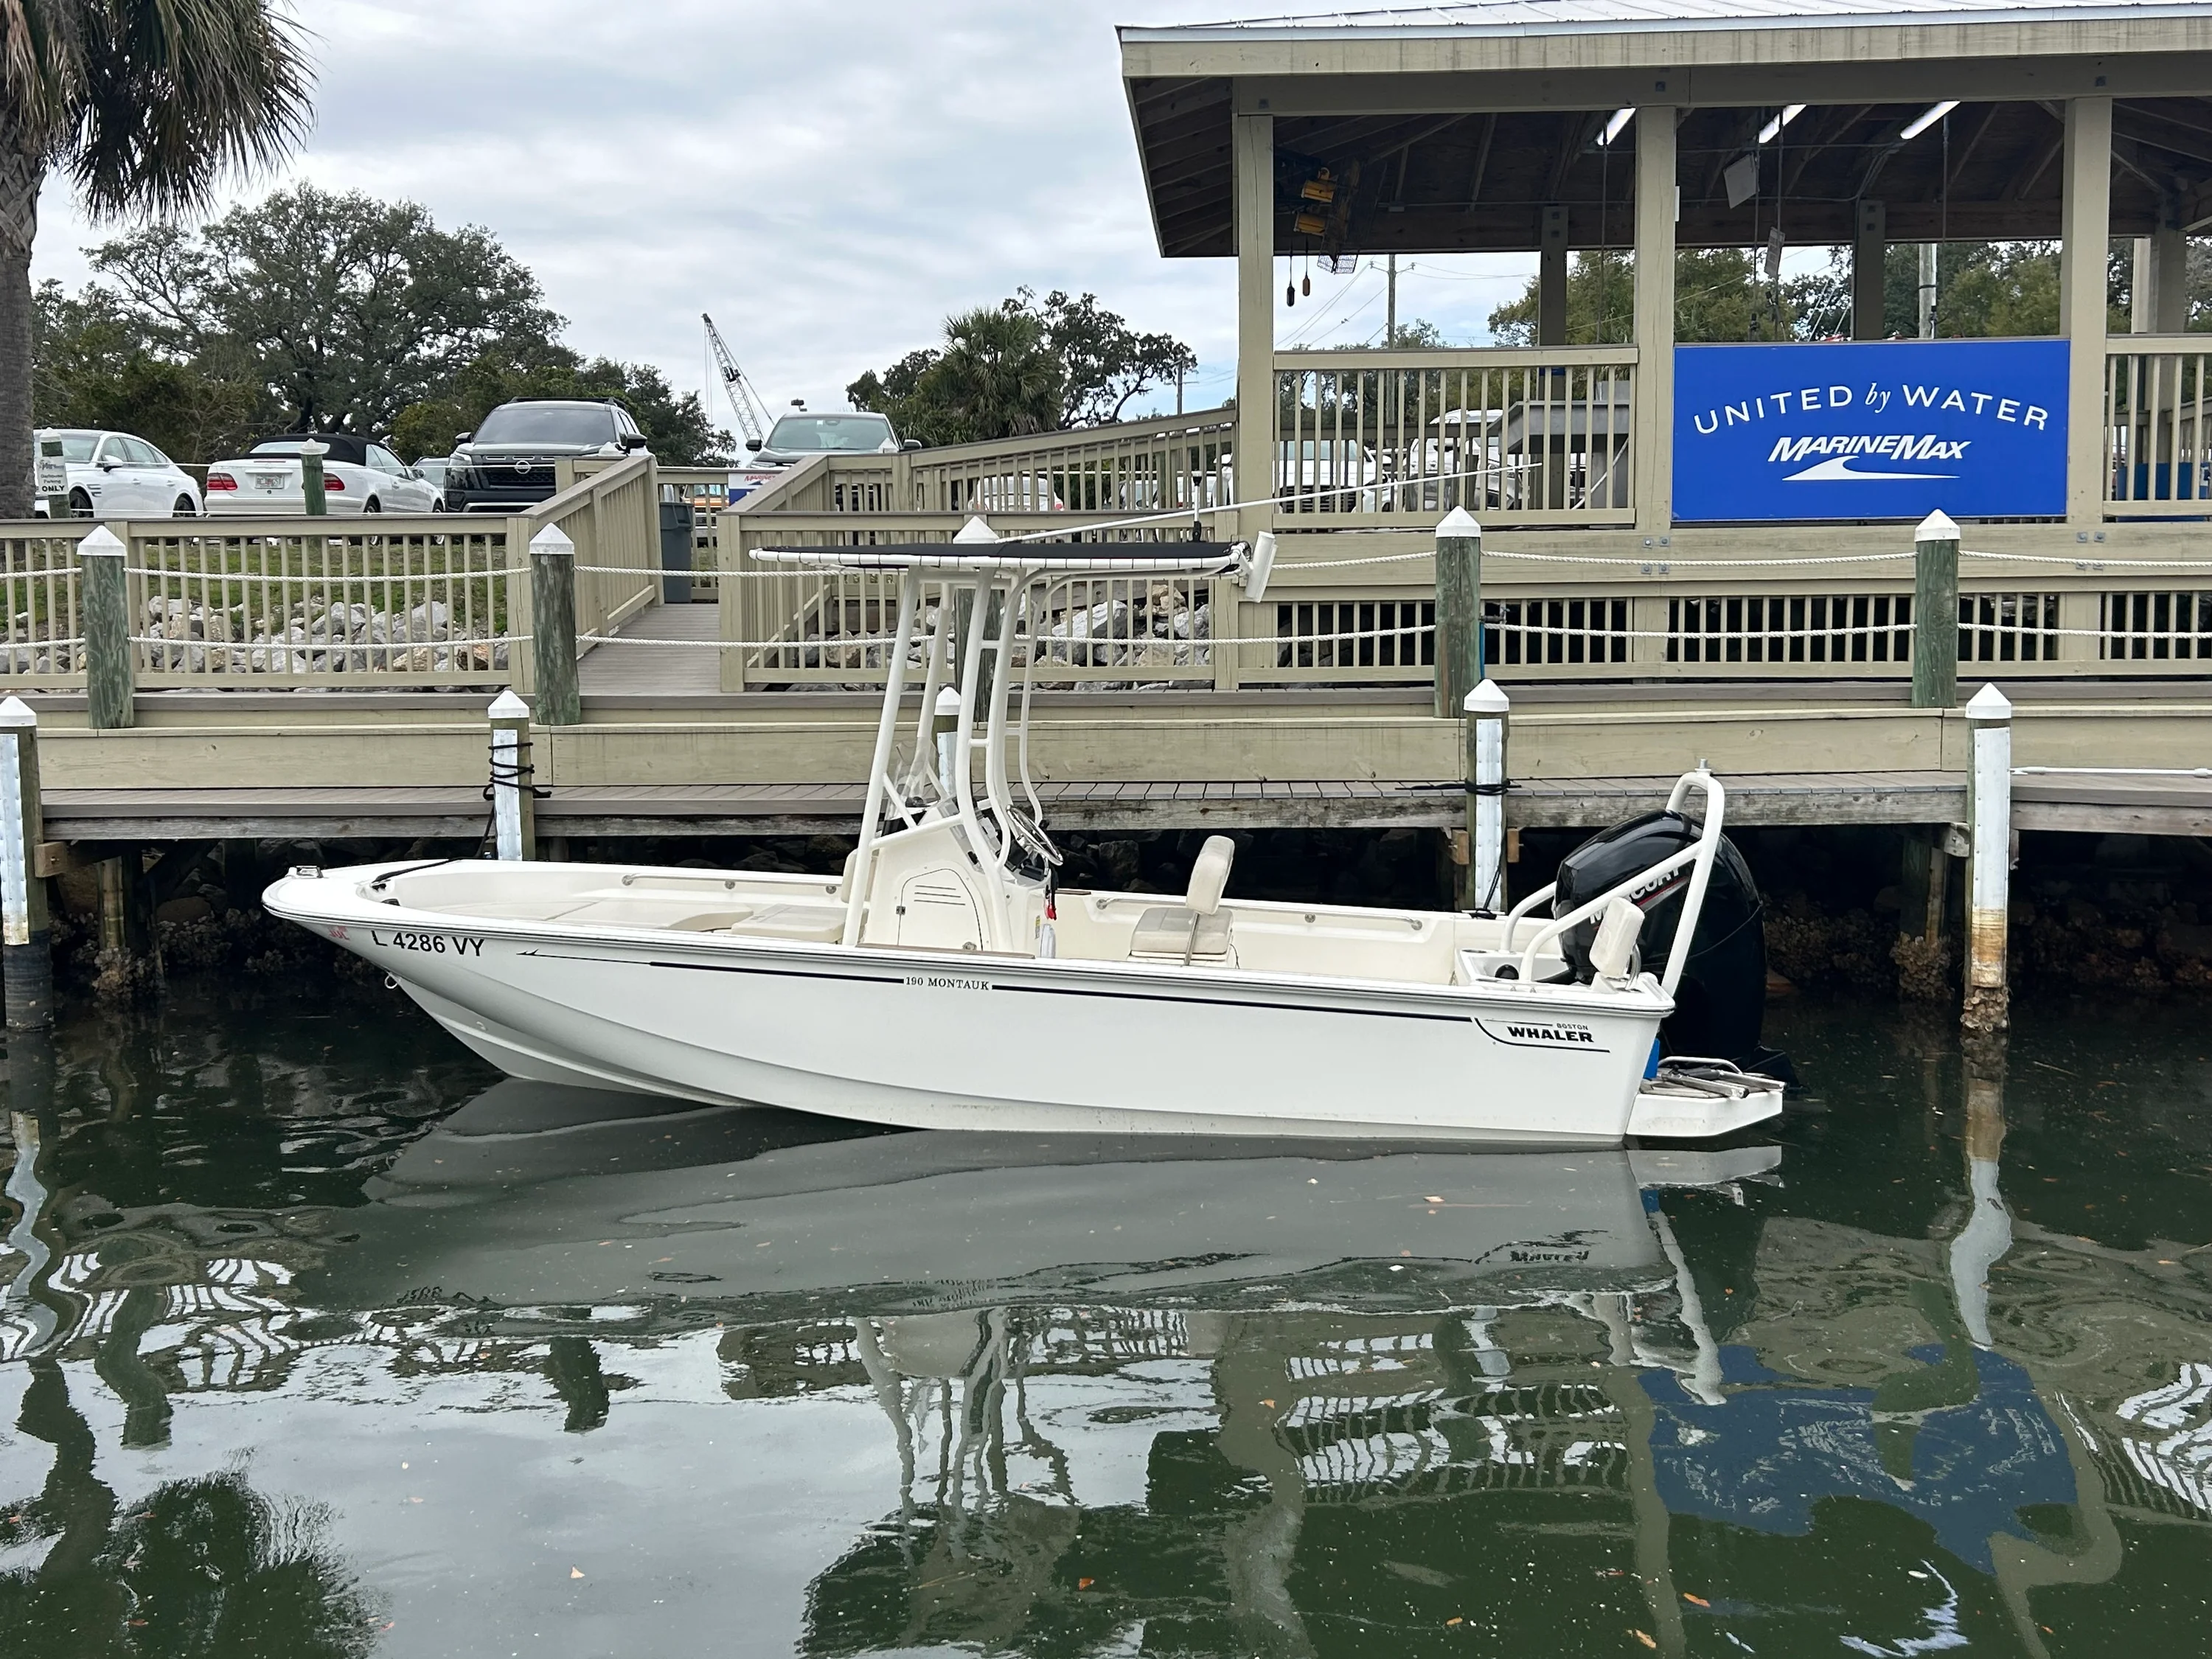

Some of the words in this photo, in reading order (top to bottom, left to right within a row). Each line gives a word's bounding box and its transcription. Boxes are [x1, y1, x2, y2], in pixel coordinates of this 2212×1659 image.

[1694, 386, 1852, 434] UNITED
[1865, 383, 1891, 414] by
[1902, 384, 2049, 431] WATER
[371, 930, 388, 947] L
[393, 932, 446, 953] 4286
[451, 936, 485, 957] VY
[905, 976, 924, 986] 190
[928, 978, 990, 990] MONTAUK
[1506, 1026, 1594, 1043] WHALER
[1556, 1023, 1589, 1032] BOSTON
